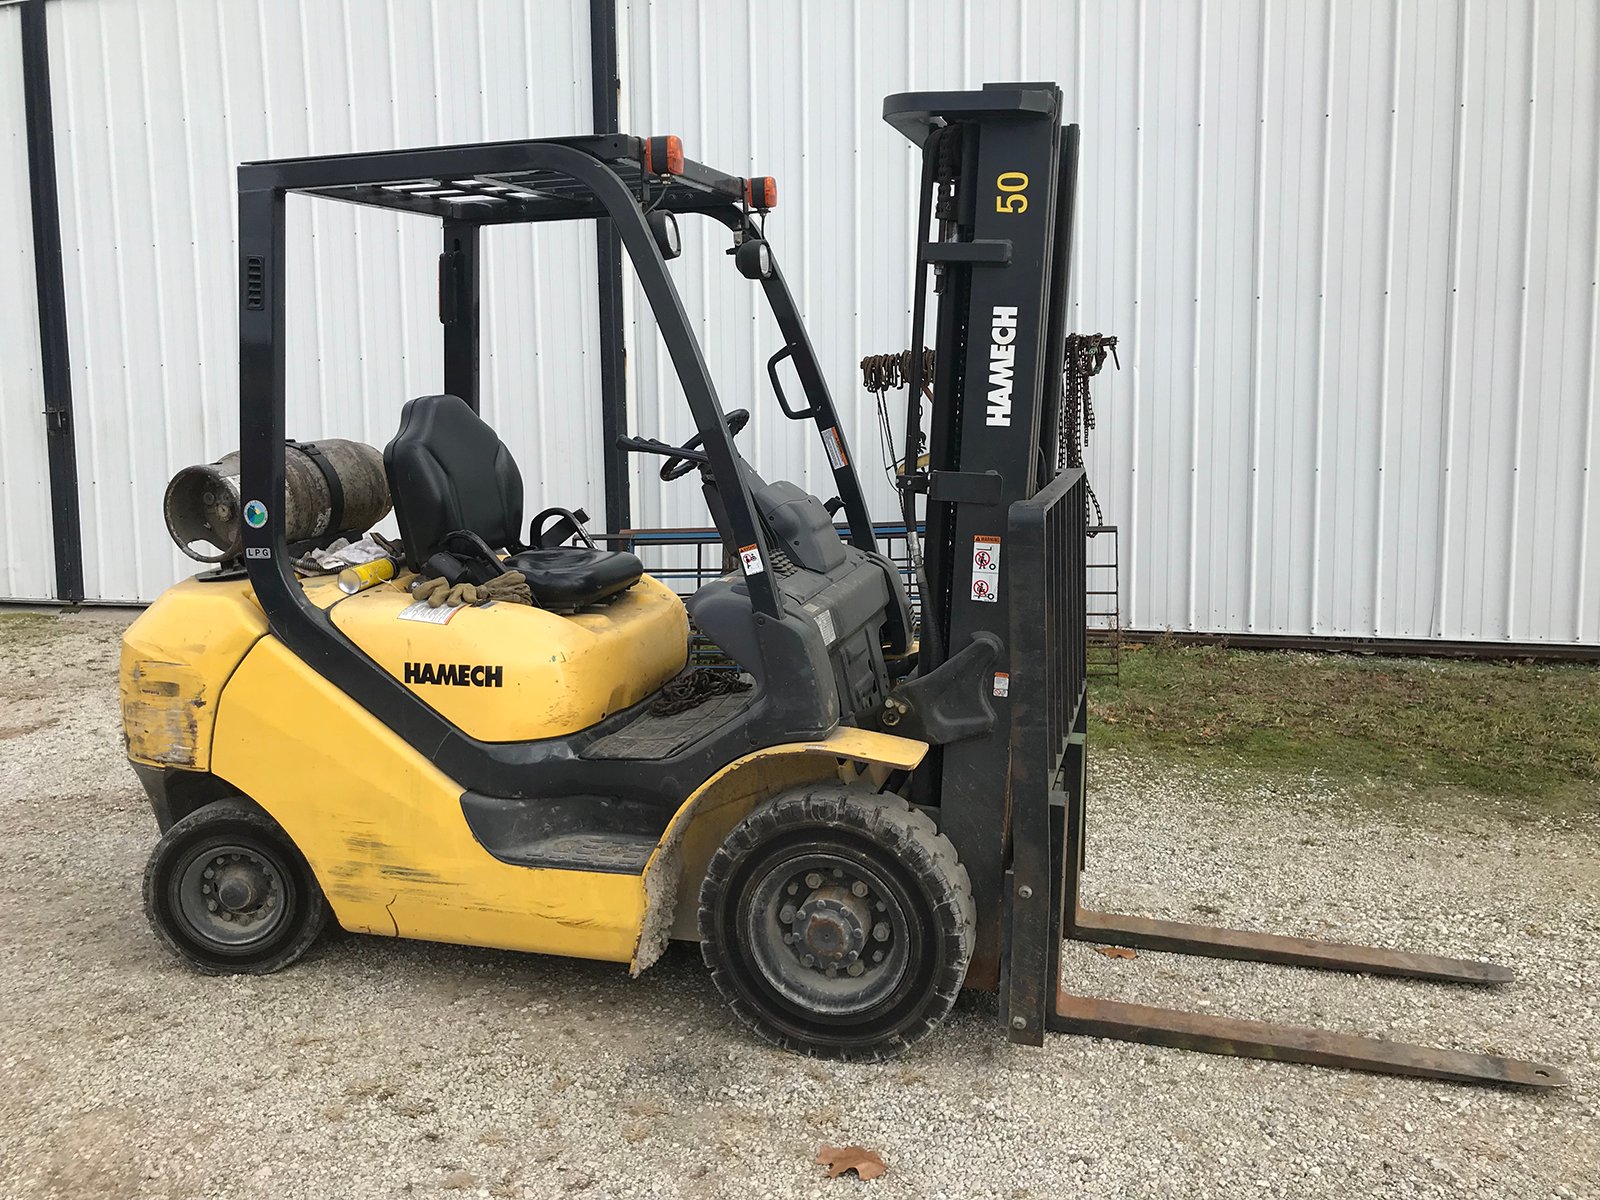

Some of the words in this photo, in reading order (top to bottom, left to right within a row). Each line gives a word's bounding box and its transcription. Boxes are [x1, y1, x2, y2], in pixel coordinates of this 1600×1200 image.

[996, 171, 1029, 214] 50
[986, 306, 1018, 427] HAMECH
[247, 548, 269, 557] LPG
[404, 662, 503, 688] HAMECH
